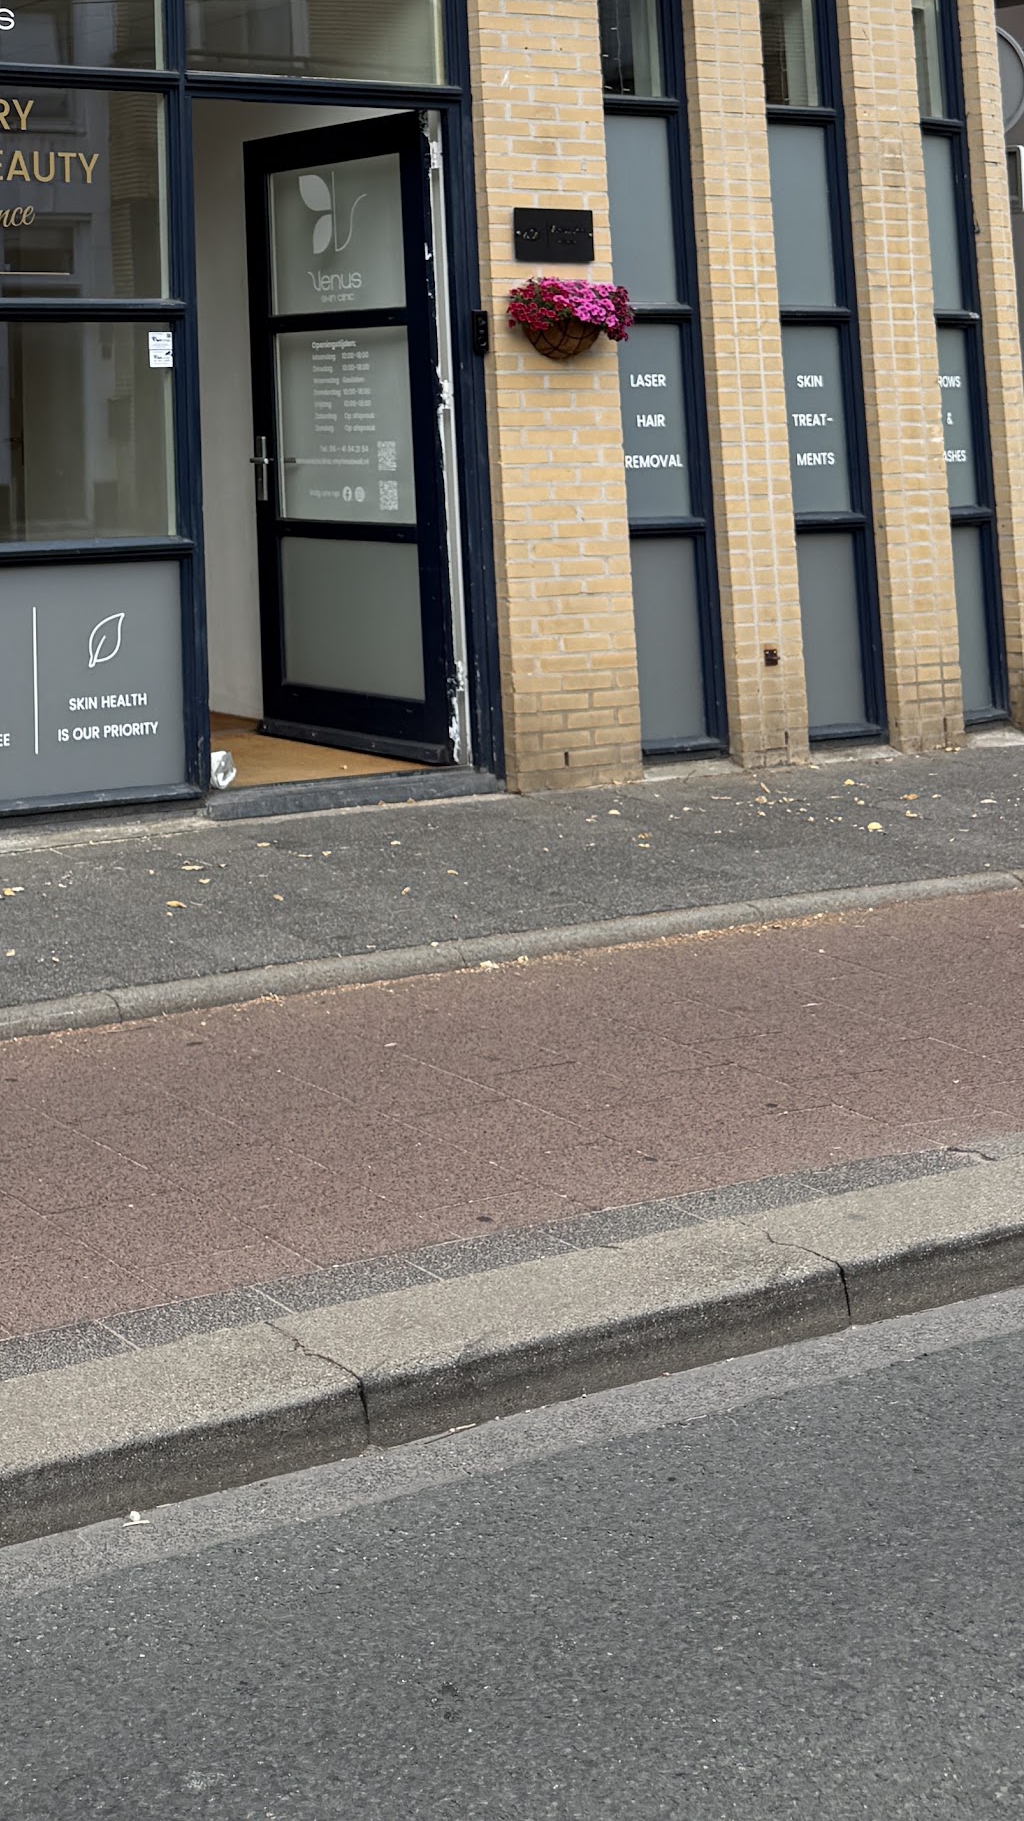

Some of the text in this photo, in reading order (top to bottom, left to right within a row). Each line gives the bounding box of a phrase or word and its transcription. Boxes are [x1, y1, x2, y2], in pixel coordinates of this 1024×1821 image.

[306, 270, 363, 292] Venus
[629, 373, 667, 388] LASER
[796, 374, 824, 388] SKIN
[937, 375, 961, 388] ROWS
[636, 413, 666, 428] HAIR
[791, 413, 834, 427] TREAT-
[946, 412, 954, 426] &
[624, 454, 683, 469] REMOVAL
[796, 452, 835, 466] MENTS
[942, 450, 967, 462] ASHES
[68, 692, 148, 711] SKIN HEALTH
[57, 721, 159, 743] IS OUR PRIORITY
